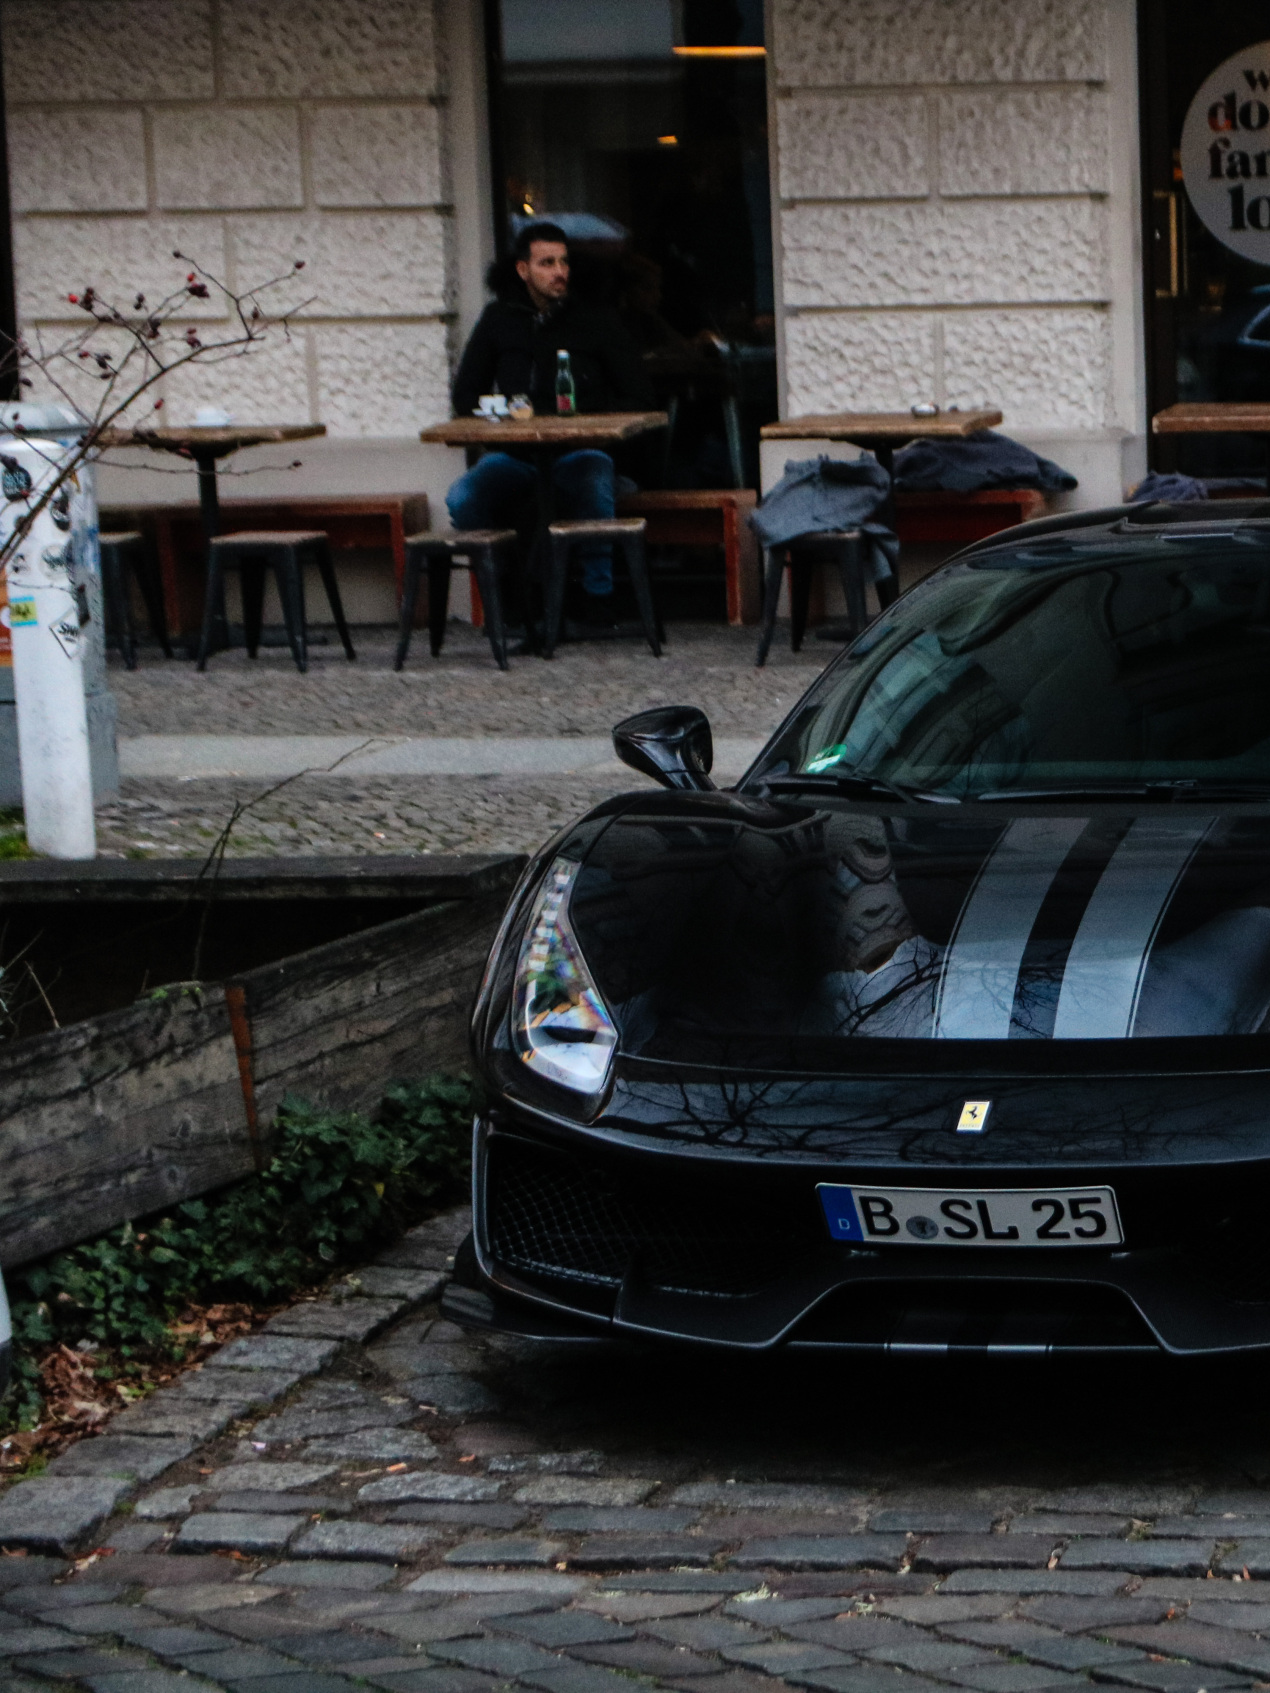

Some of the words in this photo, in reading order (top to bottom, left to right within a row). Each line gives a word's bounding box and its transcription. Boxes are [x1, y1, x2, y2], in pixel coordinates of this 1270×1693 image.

[1207, 91, 1270, 132] do
[858, 1195, 900, 1236] B
[939, 1198, 1020, 1240] SL
[1031, 1196, 1107, 1239] 25
